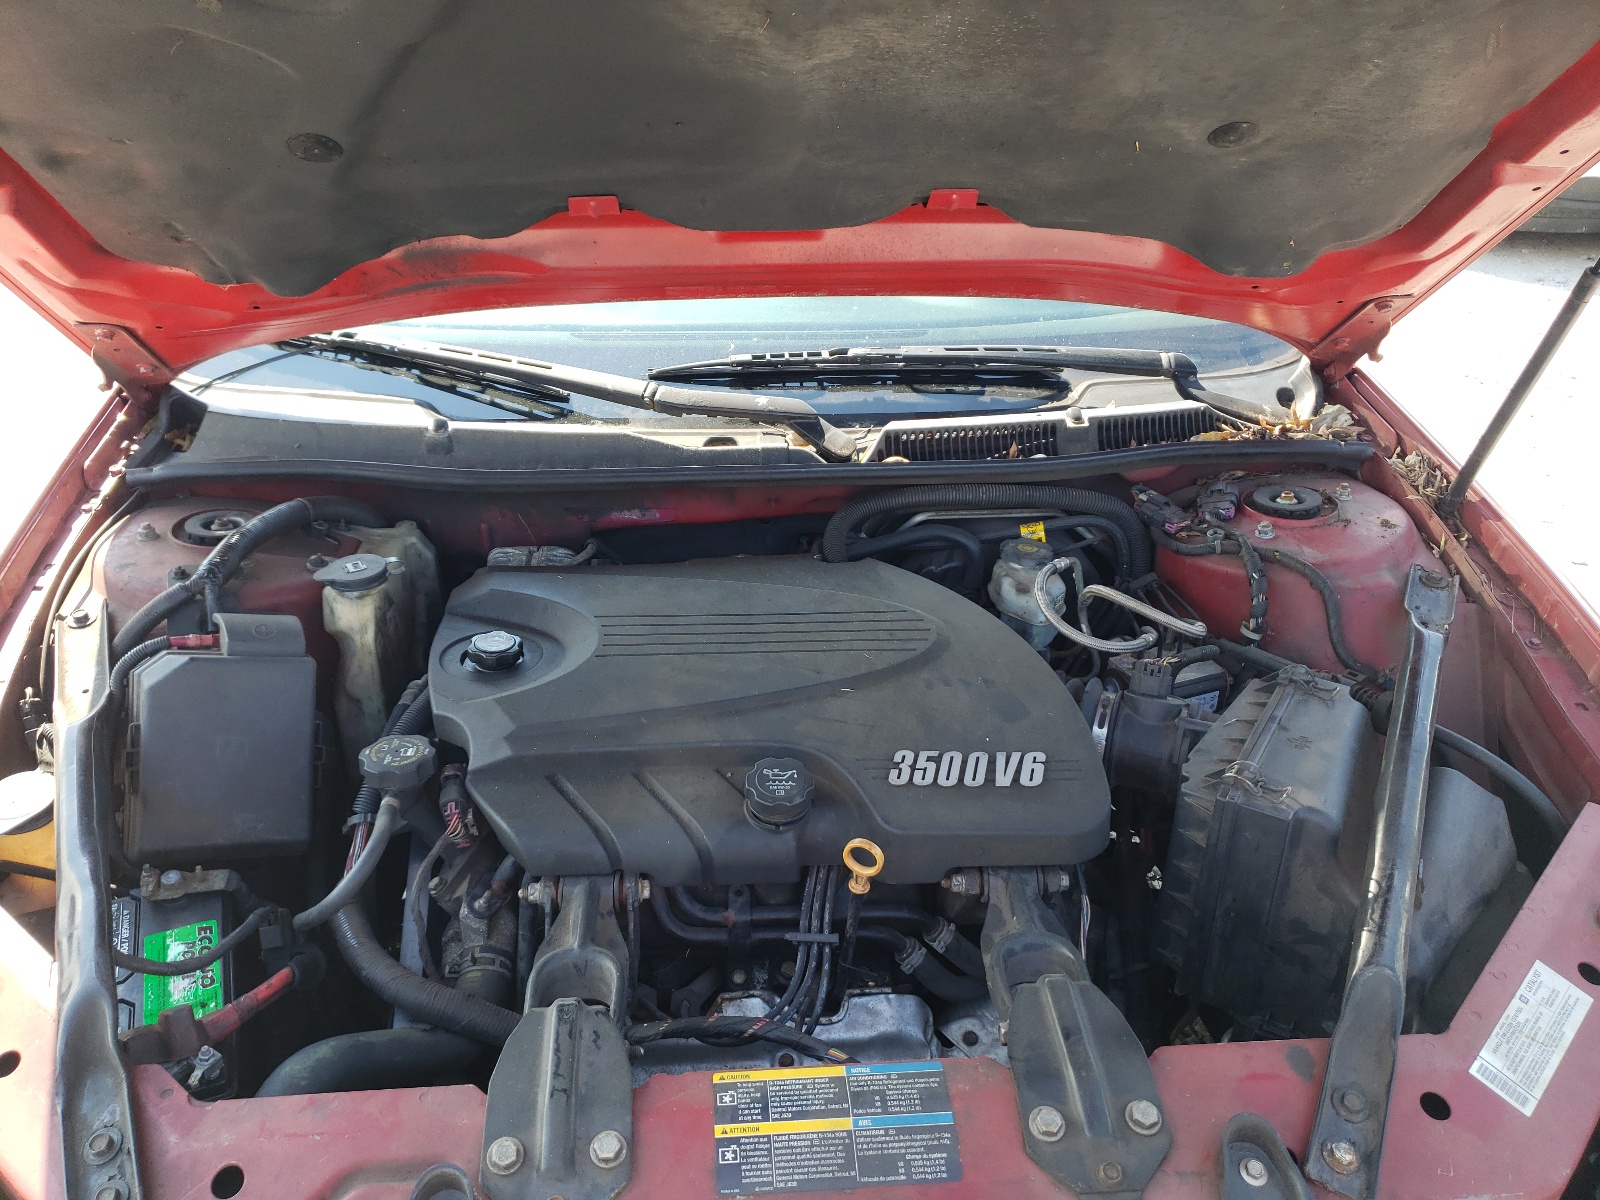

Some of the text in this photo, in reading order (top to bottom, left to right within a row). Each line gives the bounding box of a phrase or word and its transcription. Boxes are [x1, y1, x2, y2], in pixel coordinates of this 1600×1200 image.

[888, 749, 1047, 787] 3500 V6
[1524, 969, 1542, 994] CATALYST
